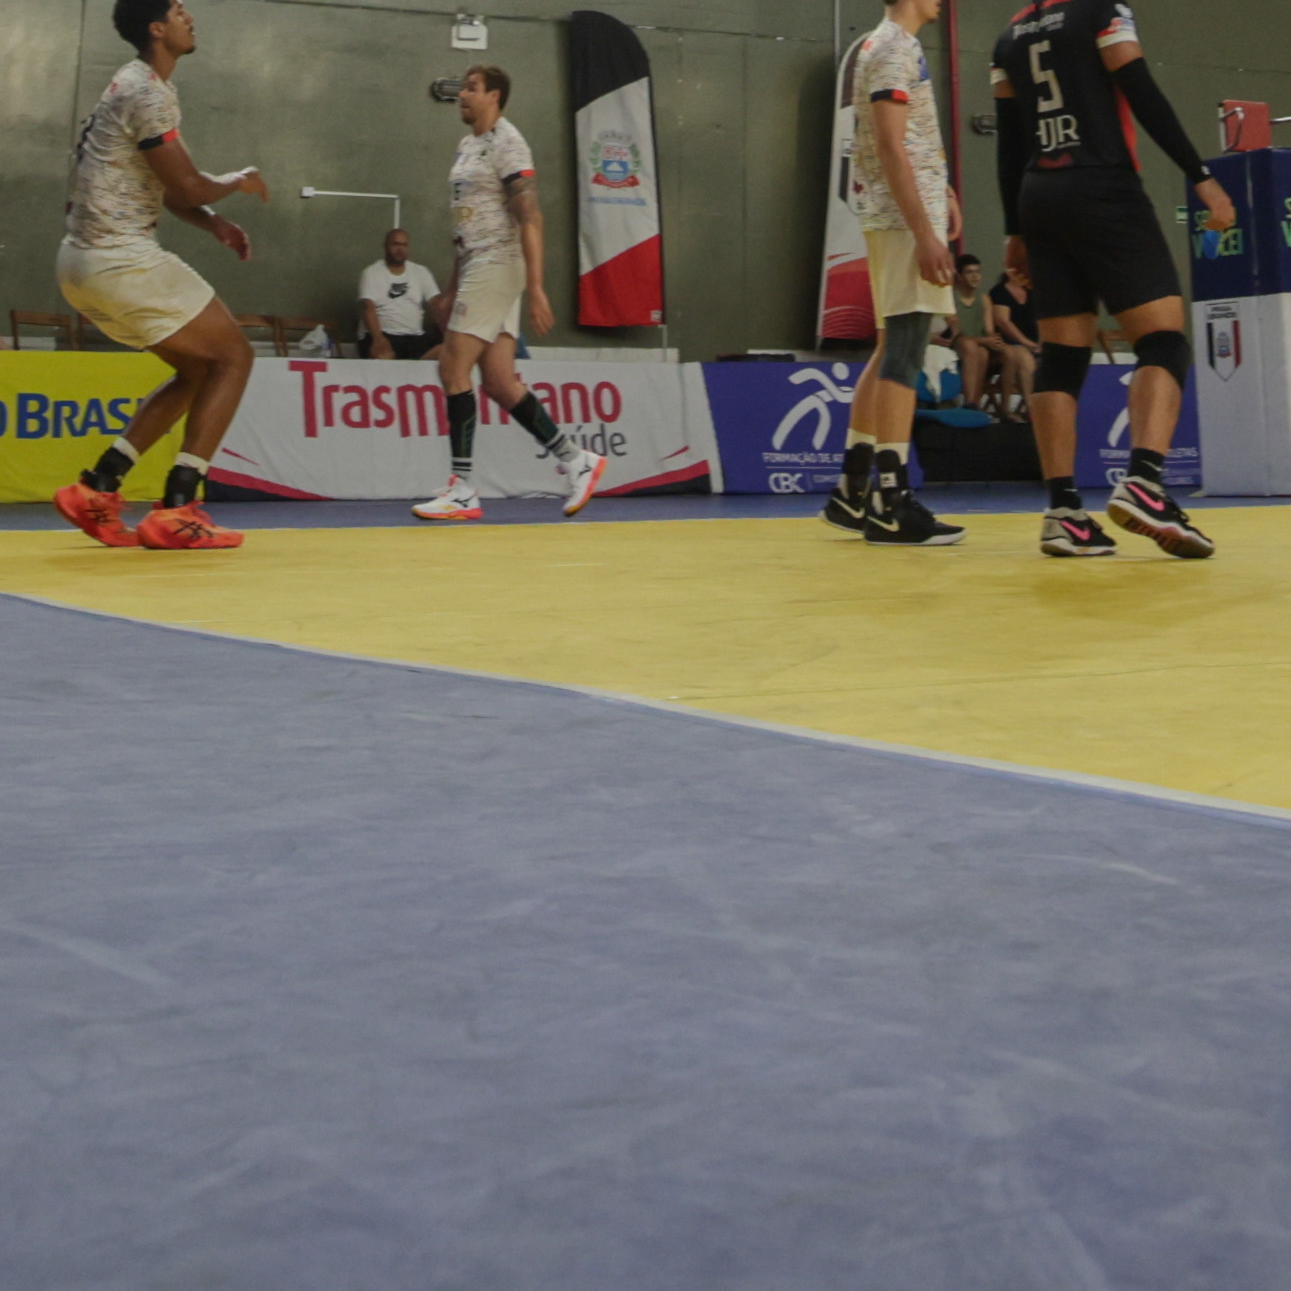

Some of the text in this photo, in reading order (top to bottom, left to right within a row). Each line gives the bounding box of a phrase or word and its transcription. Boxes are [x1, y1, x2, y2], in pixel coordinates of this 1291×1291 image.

[1029, 40, 1064, 113] 5
[16, 393, 171, 439] BRAS
[288, 360, 622, 438] Trasmnano
[536, 423, 627, 459] úde
